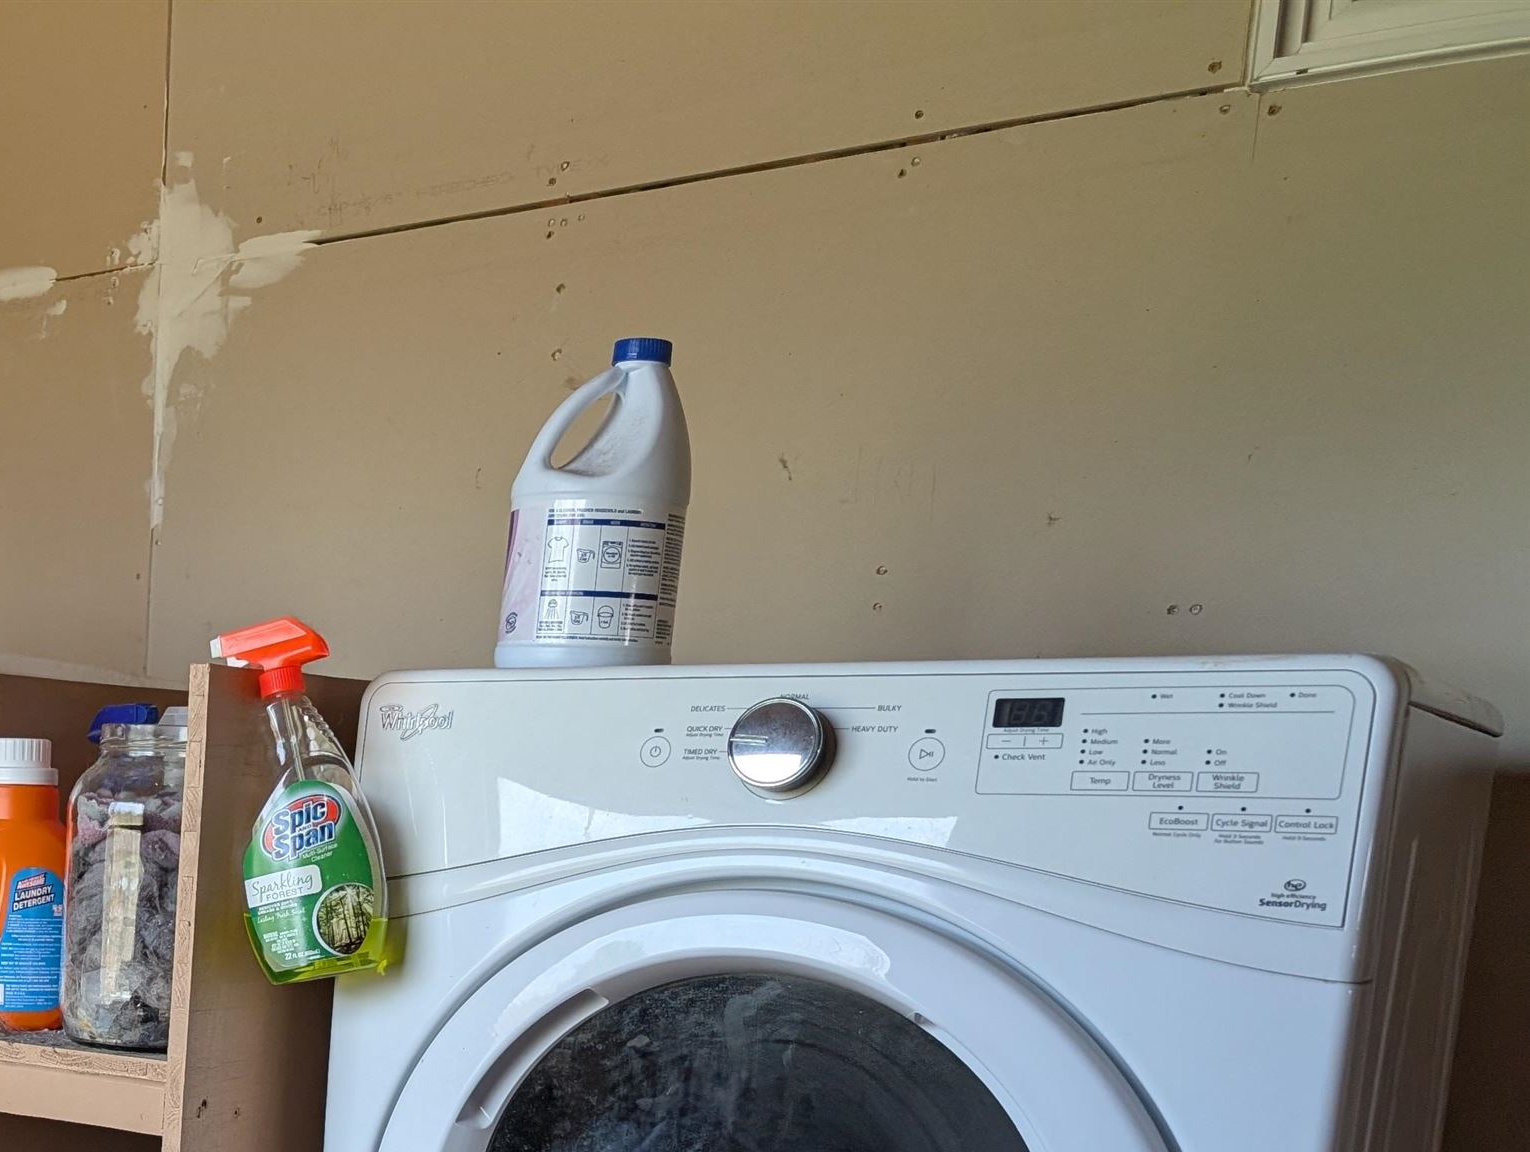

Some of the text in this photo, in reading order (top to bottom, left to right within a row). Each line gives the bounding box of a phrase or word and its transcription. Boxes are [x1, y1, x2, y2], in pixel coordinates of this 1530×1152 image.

[690, 705, 726, 713] DELICATES
[877, 704, 903, 712] BULKY
[380, 705, 454, 739] Whirlpool
[686, 725, 707, 733] QUICK
[851, 725, 899, 733] HEAVY DUTY
[1091, 728, 1109, 736] High
[1001, 753, 1046, 761] Check Vent
[1098, 759, 1116, 767] Only
[1214, 759, 1227, 767] Off
[1090, 776, 1112, 786] Temp
[1148, 773, 1181, 783] Dryness
[1212, 773, 1246, 782] Wrinkle
[1152, 781, 1175, 790] Level
[1213, 781, 1241, 790] Shield
[271, 801, 328, 837] Spic
[1159, 817, 1199, 827] EcoBoost
[1215, 818, 1269, 829] Cycle Signal
[1278, 819, 1335, 830] Control Lock
[272, 820, 335, 861] Span
[252, 872, 313, 903] Sparkling
[14, 885, 53, 902] LAUNDRY
[266, 886, 304, 902] FOREST
[13, 894, 55, 911] DETERGENT
[1258, 898, 1327, 912] SensorDrying
[284, 952, 293, 961] 22
